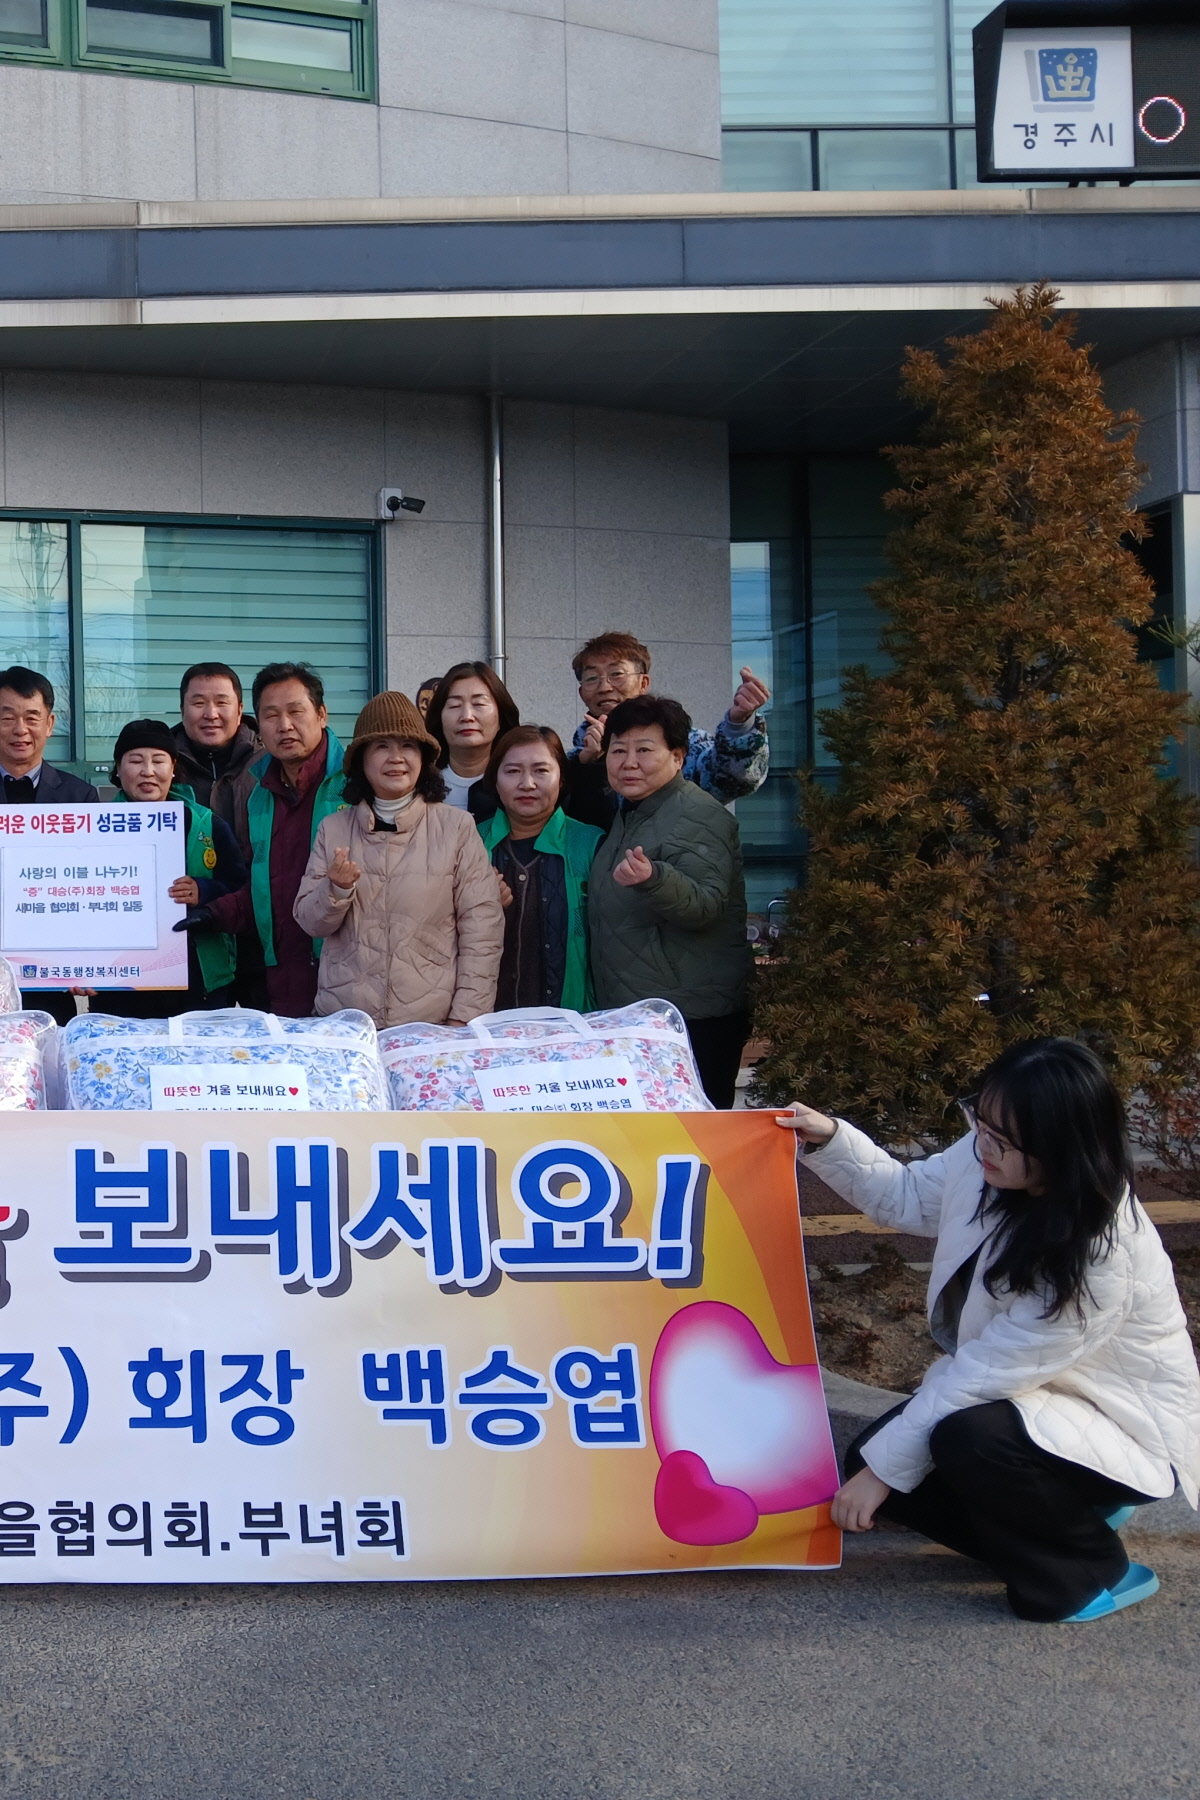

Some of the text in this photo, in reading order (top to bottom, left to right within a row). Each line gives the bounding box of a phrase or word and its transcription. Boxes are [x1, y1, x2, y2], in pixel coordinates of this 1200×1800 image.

[1013, 123, 1114, 150] 경주시
[30, 813, 91, 835] 이웃돕기
[96, 812, 142, 833] 성금품
[146, 811, 178, 832] 기탁
[19, 865, 138, 880] 사랑의 이불 나누기!
[110, 885, 141, 896] 백승엽
[15, 902, 47, 914] 새마을
[49, 901, 80, 914] 협의회
[88, 901, 119, 913] 부녀회
[122, 900, 143, 912] 일동
[39, 965, 141, 979] 불국동행정복지센터
[163, 1084, 287, 1097] 따뜻한 겨울 보내세요
[492, 1078, 617, 1098] 따뜻한 겨울 보내세요
[596, 1098, 632, 1110] 백승엽
[52, 1142, 701, 1282] 보내세요!
[127, 1347, 305, 1446] 회장
[361, 1346, 642, 1447] 백승엽
